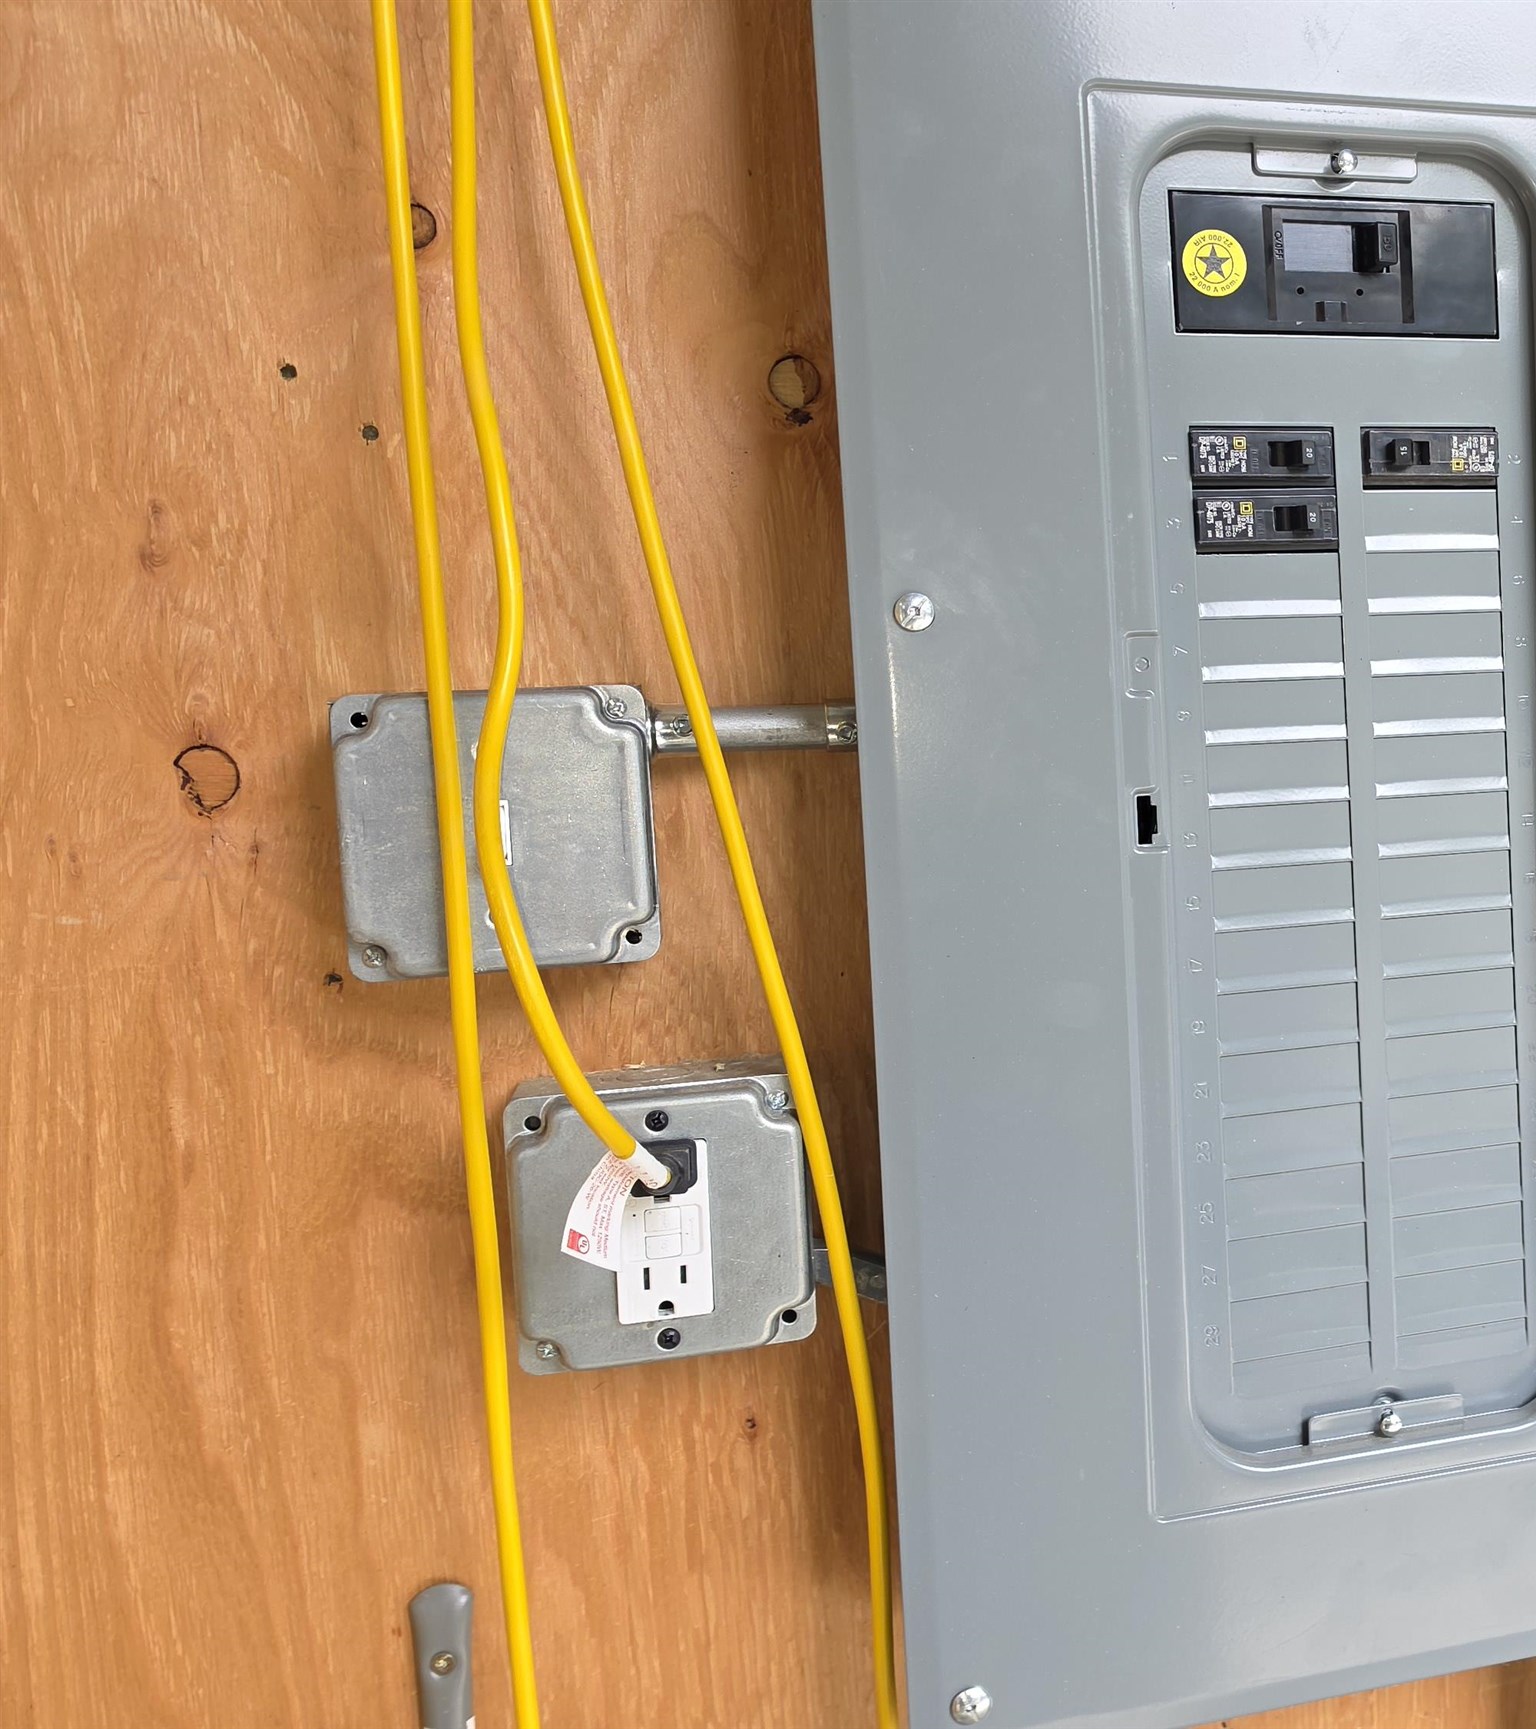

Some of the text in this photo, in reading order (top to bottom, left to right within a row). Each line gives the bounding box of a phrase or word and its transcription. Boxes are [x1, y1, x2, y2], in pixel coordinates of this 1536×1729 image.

[1193, 234, 1206, 247] AIR
[1189, 272, 1196, 281] 22
[1198, 281, 1212, 292] 000
[1306, 448, 1313, 458] 20
[1400, 446, 1407, 456] 15
[1310, 512, 1316, 522] 20
